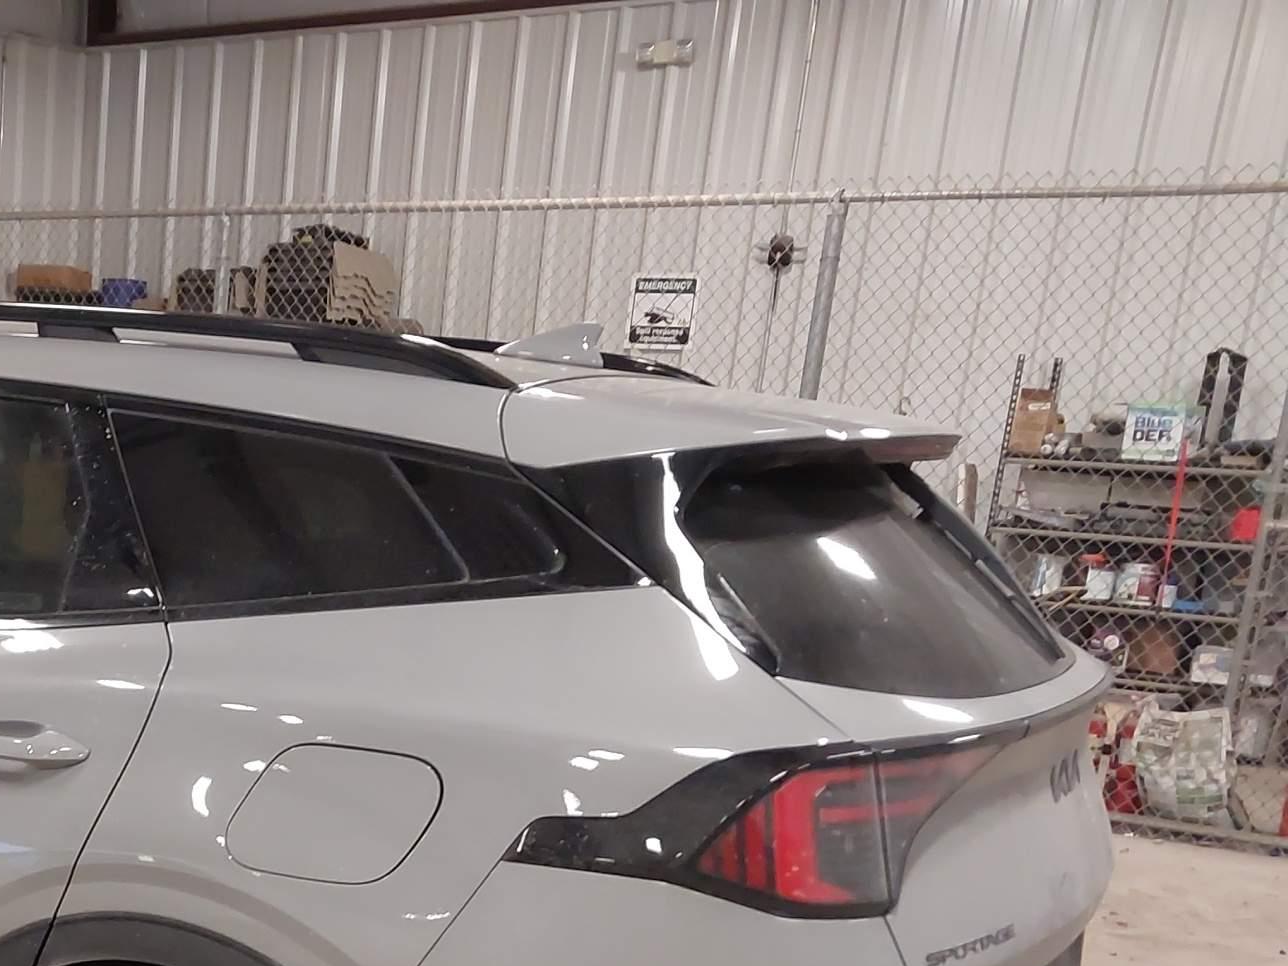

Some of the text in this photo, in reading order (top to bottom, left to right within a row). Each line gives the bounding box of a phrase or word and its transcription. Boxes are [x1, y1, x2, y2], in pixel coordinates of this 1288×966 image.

[638, 280, 693, 290] EMERGENCY
[1135, 415, 1174, 430] Blue
[1133, 429, 1171, 442] DEF
